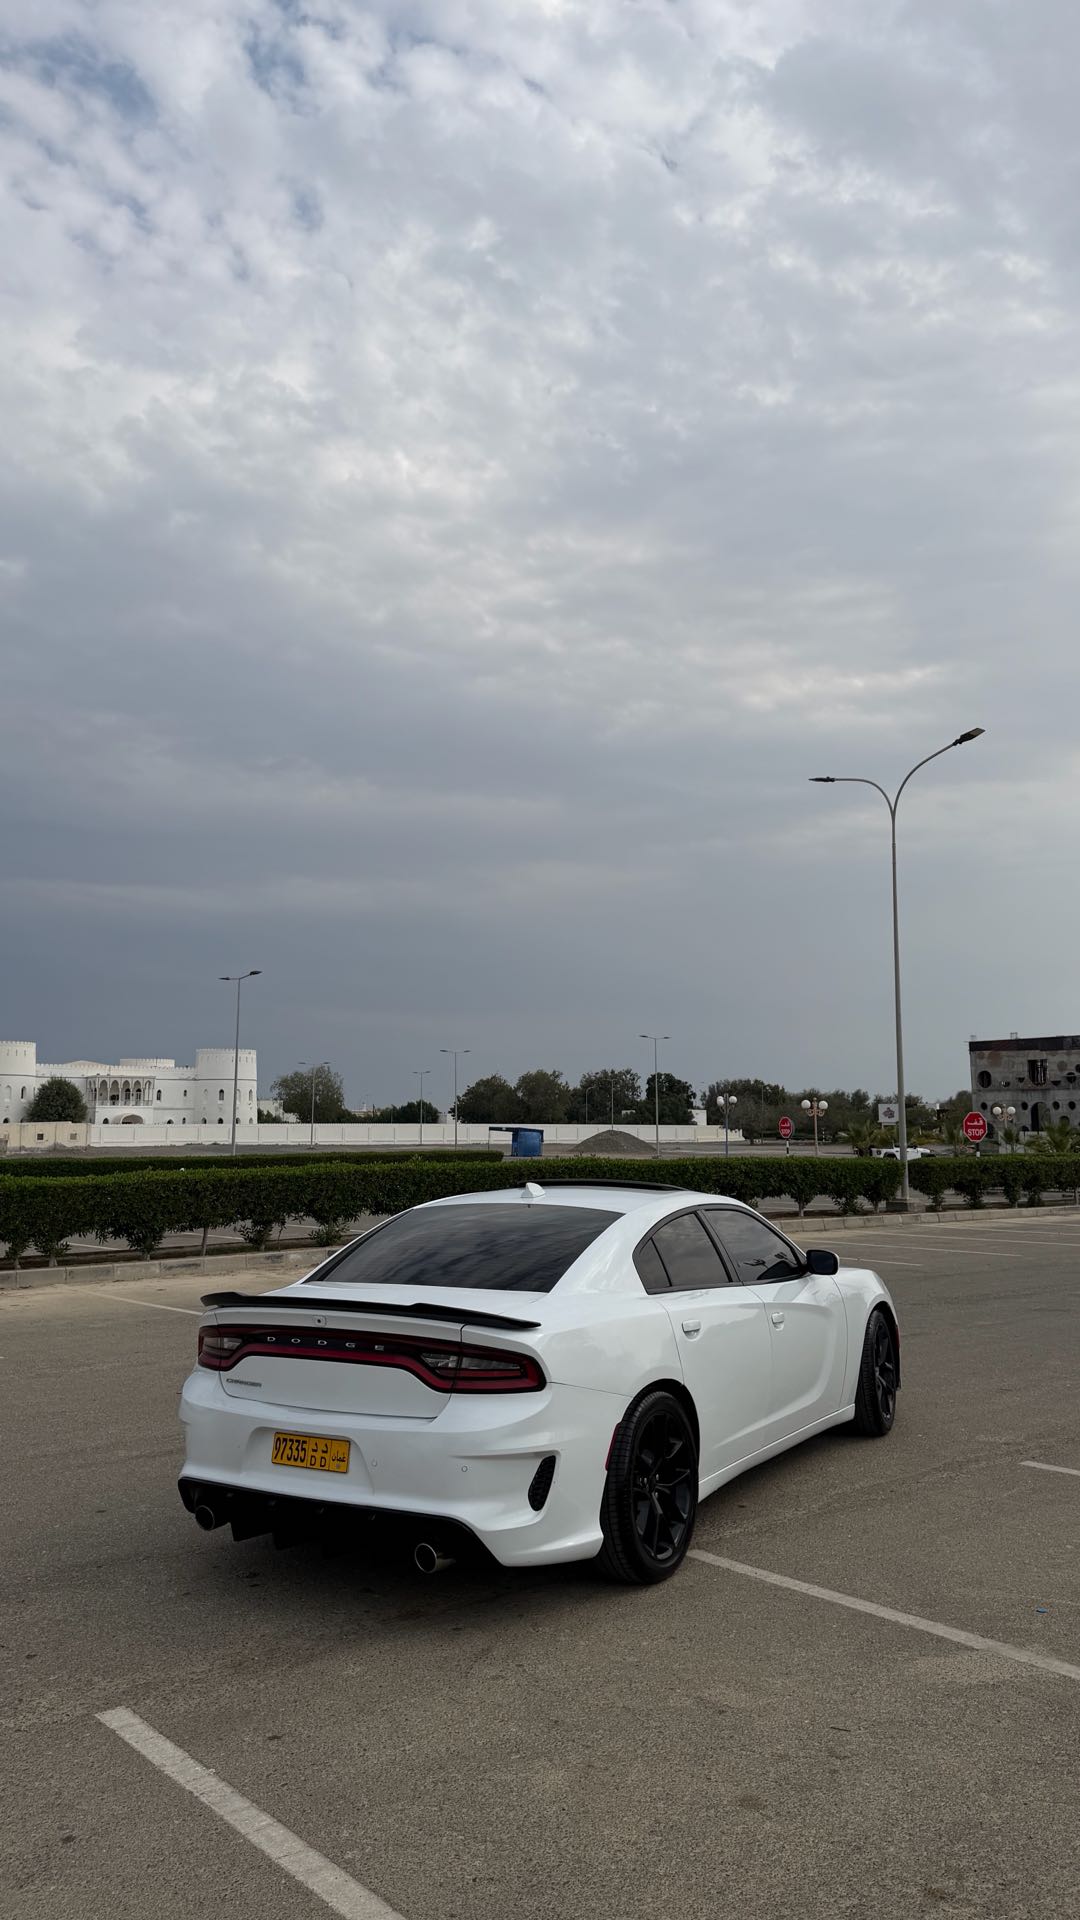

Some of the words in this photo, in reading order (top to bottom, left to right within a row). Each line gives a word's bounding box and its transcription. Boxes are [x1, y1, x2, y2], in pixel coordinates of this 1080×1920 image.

[967, 1117, 983, 1126] قف
[967, 1129, 984, 1137] STOP
[267, 1336, 385, 1351] DODGE
[274, 1437, 308, 1463] 97335
